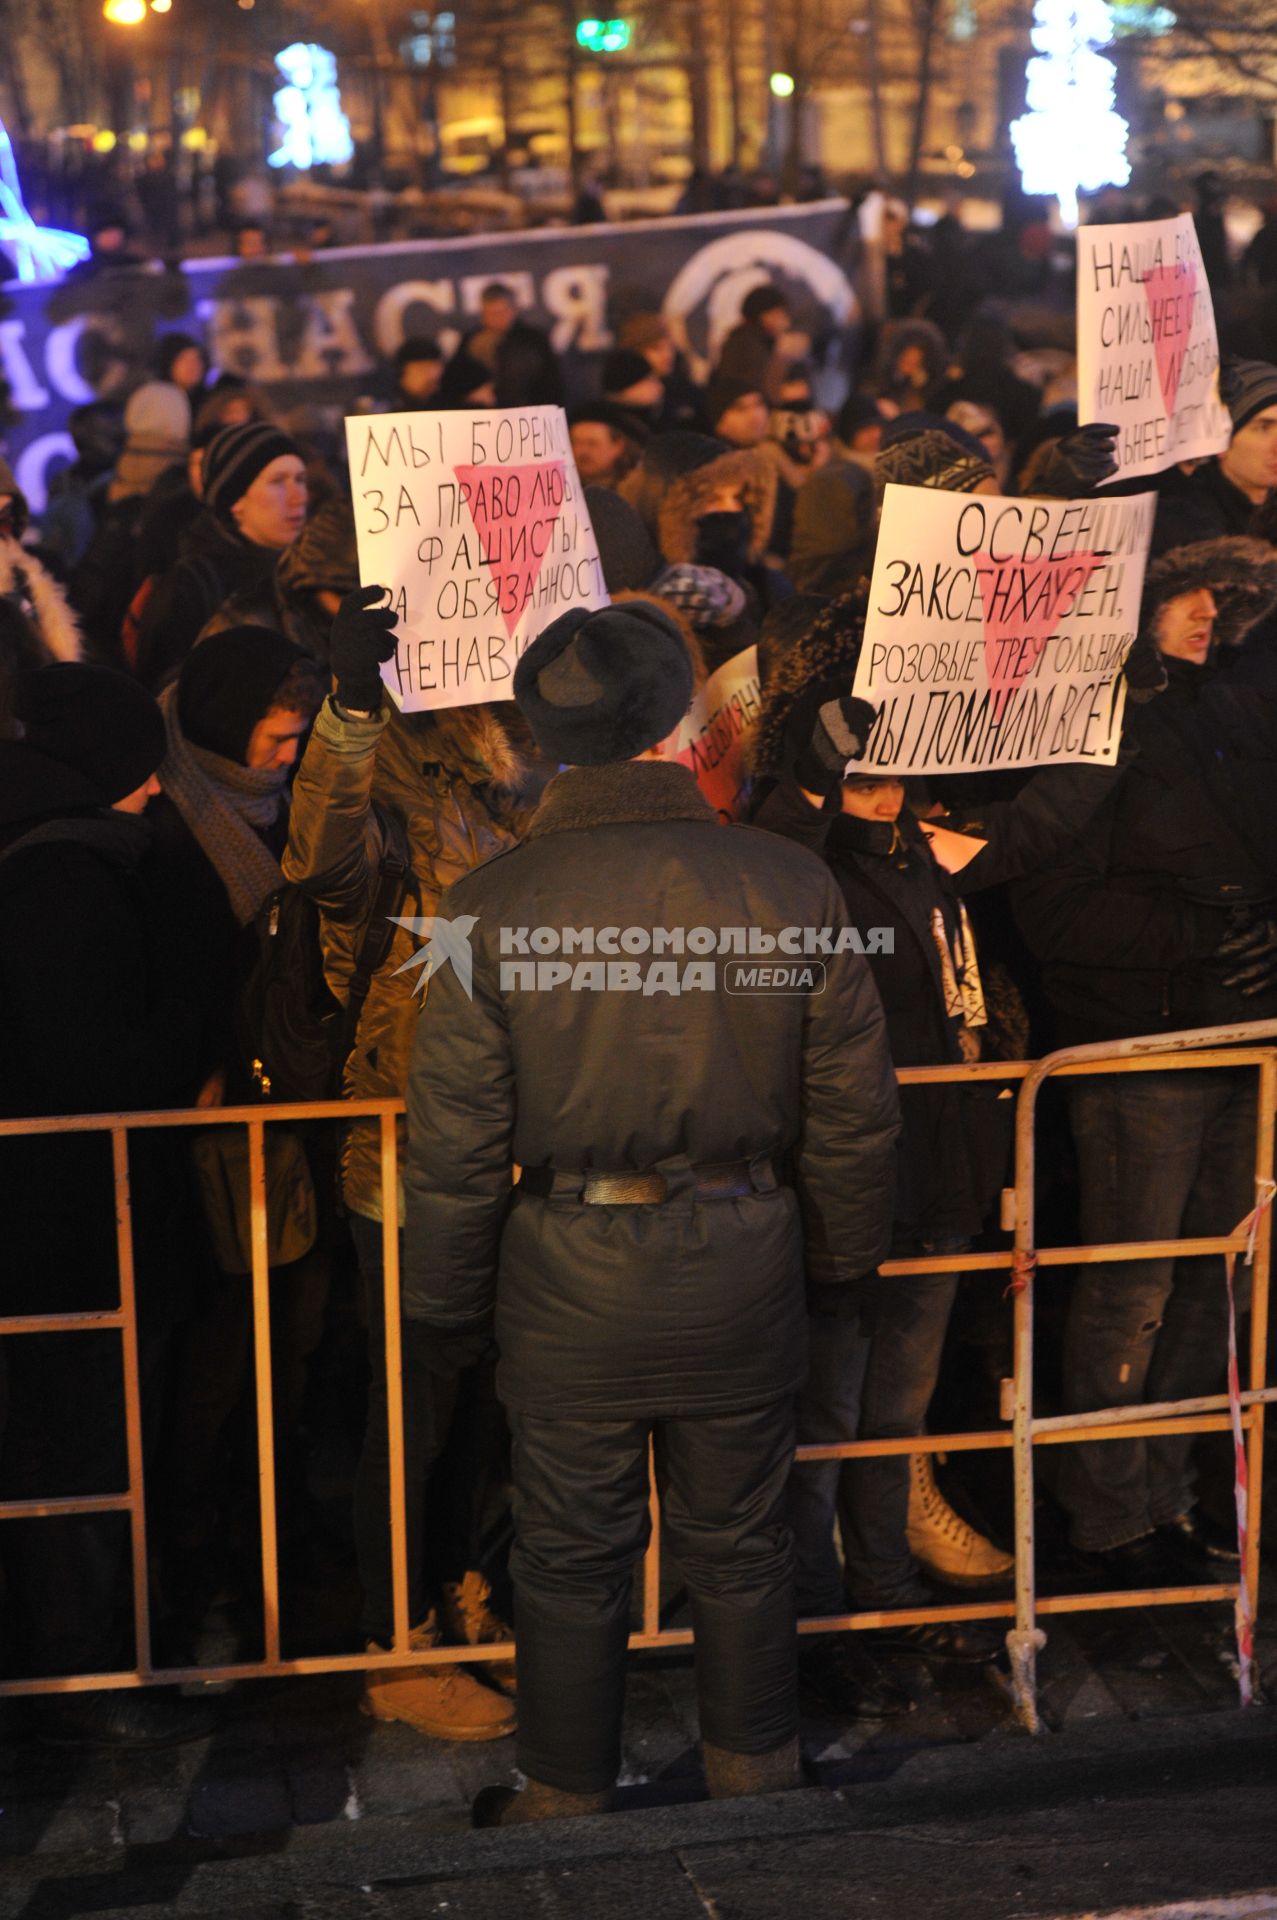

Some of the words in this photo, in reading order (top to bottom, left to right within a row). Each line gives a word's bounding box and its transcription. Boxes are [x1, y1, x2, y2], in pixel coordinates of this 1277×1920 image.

[1092, 238, 1164, 292] НАША
[1101, 295, 1183, 347] СИЛЬНЕЕ
[1099, 357, 1153, 409] НАША
[1163, 338, 1219, 396] ЛЮБОВ
[361, 422, 444, 477] МЫ
[362, 485, 421, 534] ЗА
[438, 475, 521, 528] ПРАВО
[417, 512, 578, 576] ФАШИСТЫ
[436, 556, 607, 620] ОБЯЗАННОСТ
[868, 640, 986, 687] РОЗОВЫЕ
[908, 684, 1057, 768] ПОМНИМ
